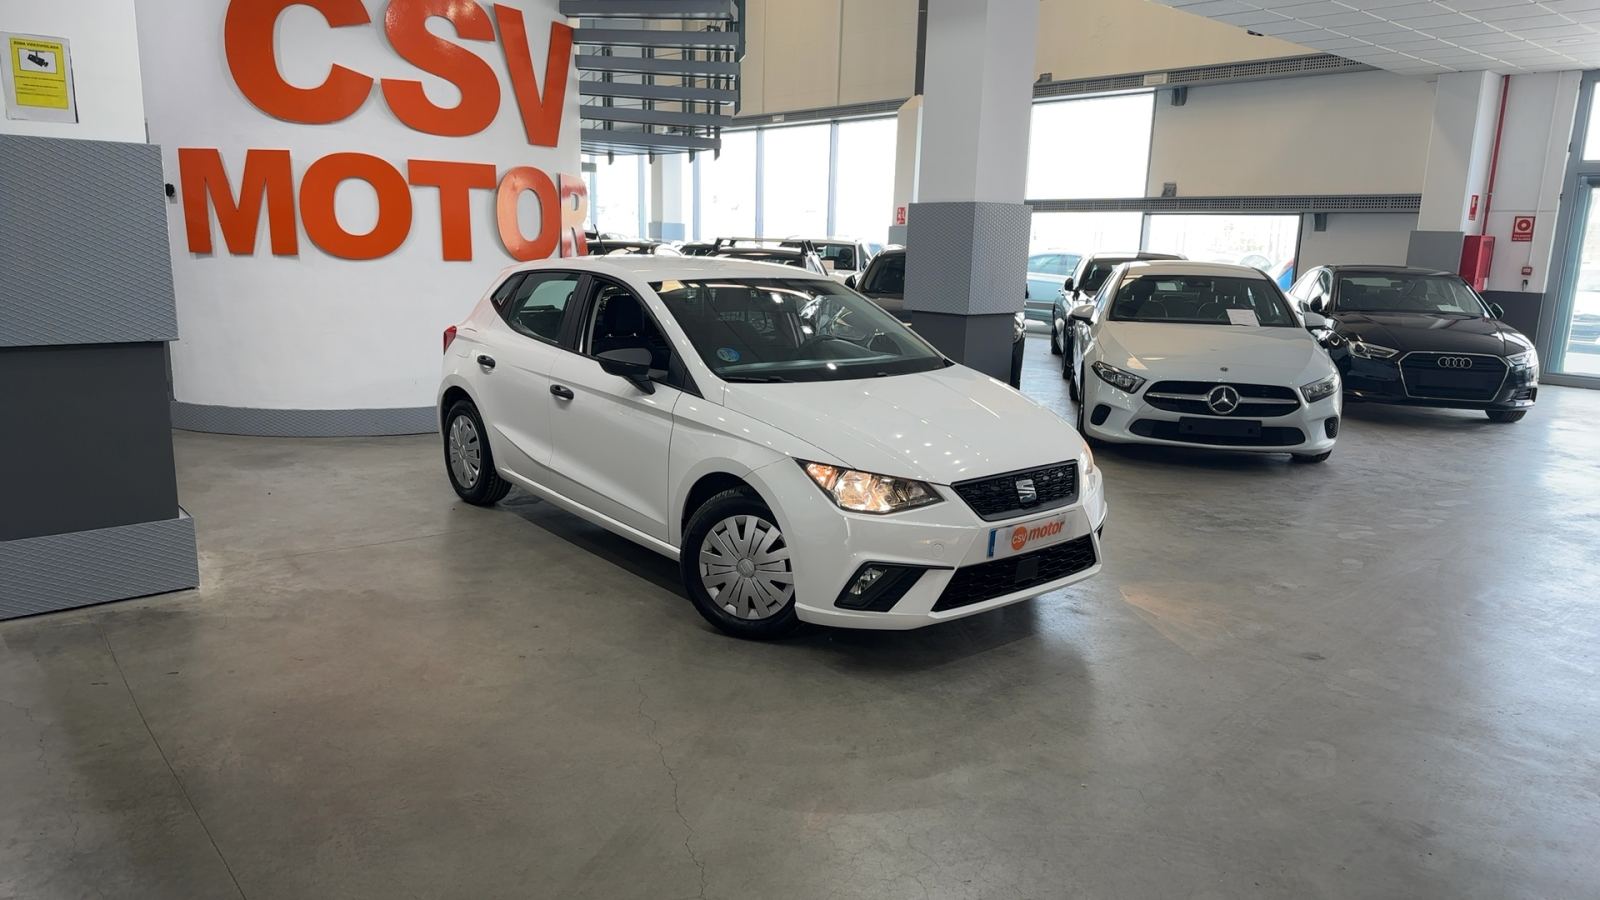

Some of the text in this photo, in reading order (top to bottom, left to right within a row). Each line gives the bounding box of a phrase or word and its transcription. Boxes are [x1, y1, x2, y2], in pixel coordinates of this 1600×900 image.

[225, 0, 574, 147] CSV
[178, 148, 589, 262] MOTOR
[1028, 521, 1064, 541] motor
